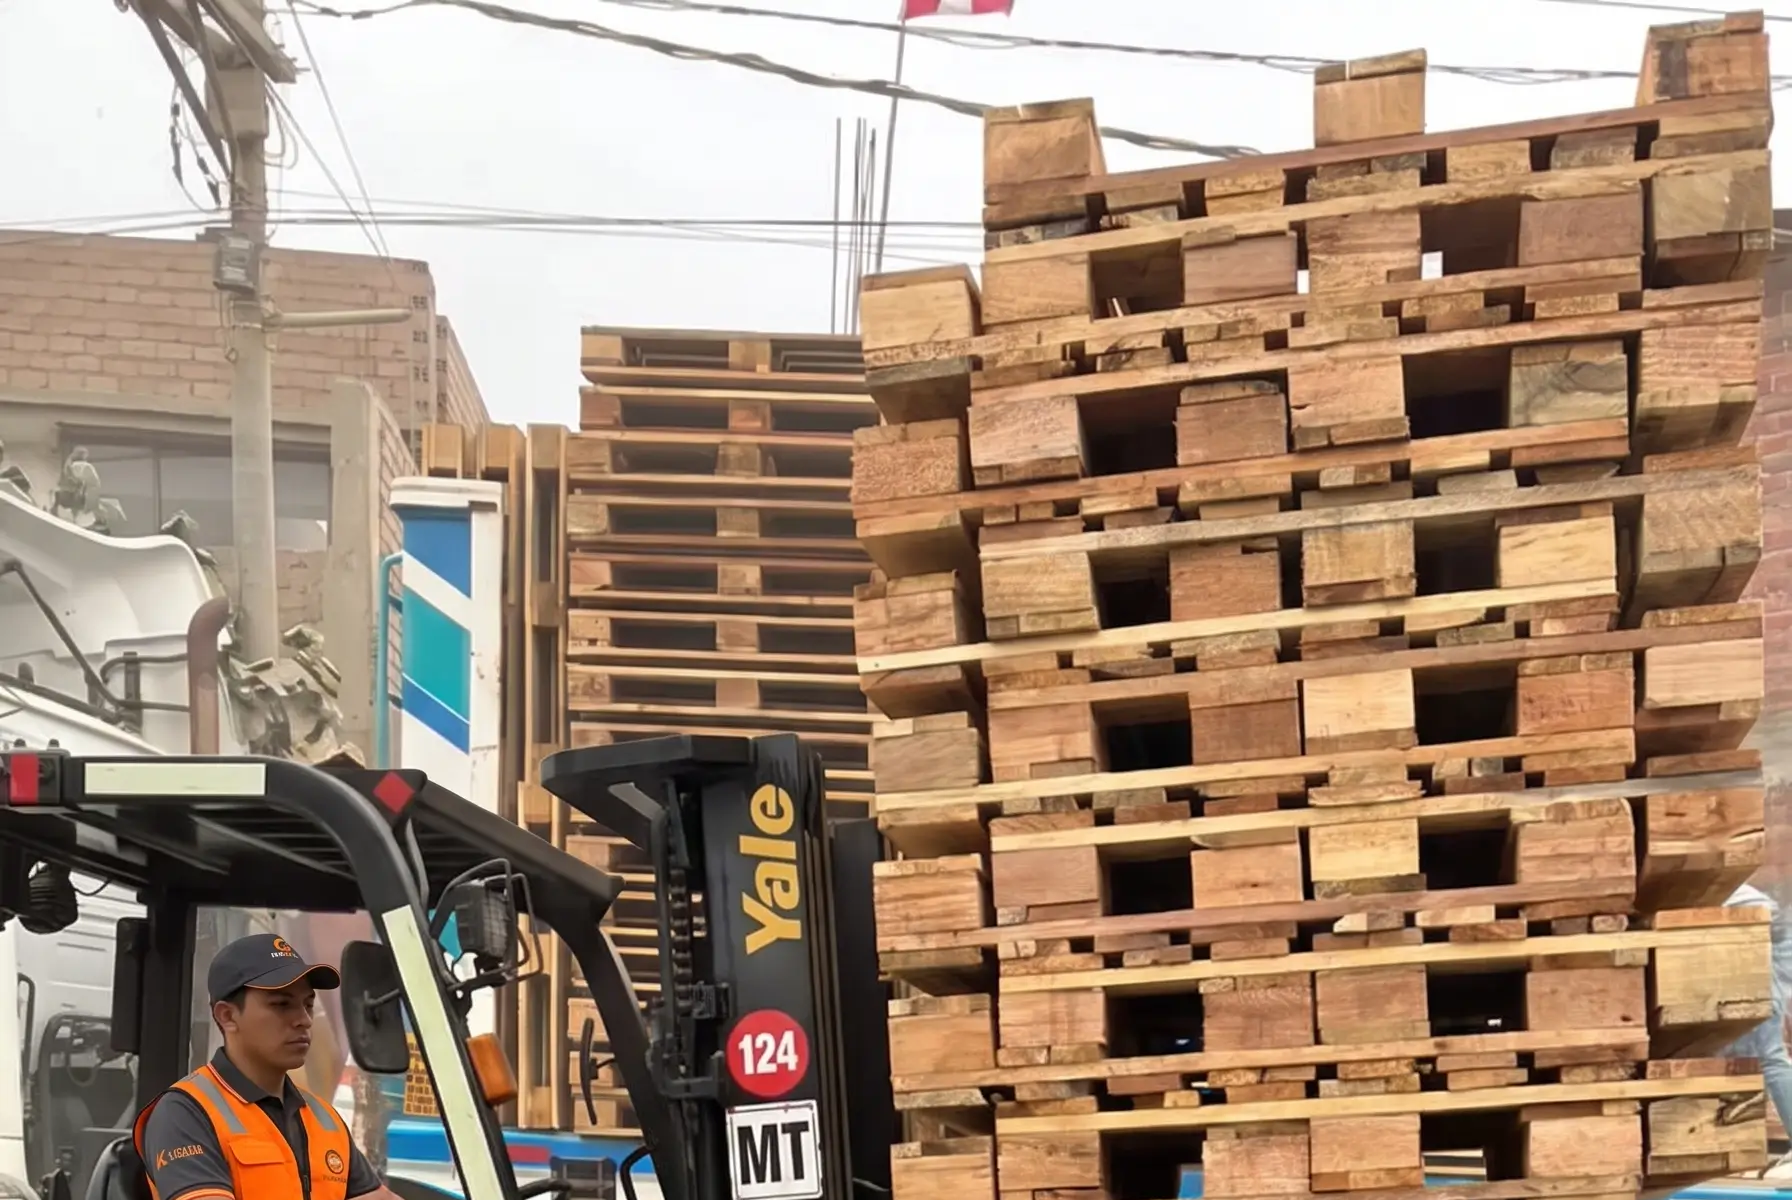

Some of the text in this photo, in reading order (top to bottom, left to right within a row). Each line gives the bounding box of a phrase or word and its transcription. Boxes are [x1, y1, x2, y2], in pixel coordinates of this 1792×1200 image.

[739, 783, 802, 955] Yale
[738, 1030, 799, 1076] 124
[737, 1120, 810, 1186] MT
